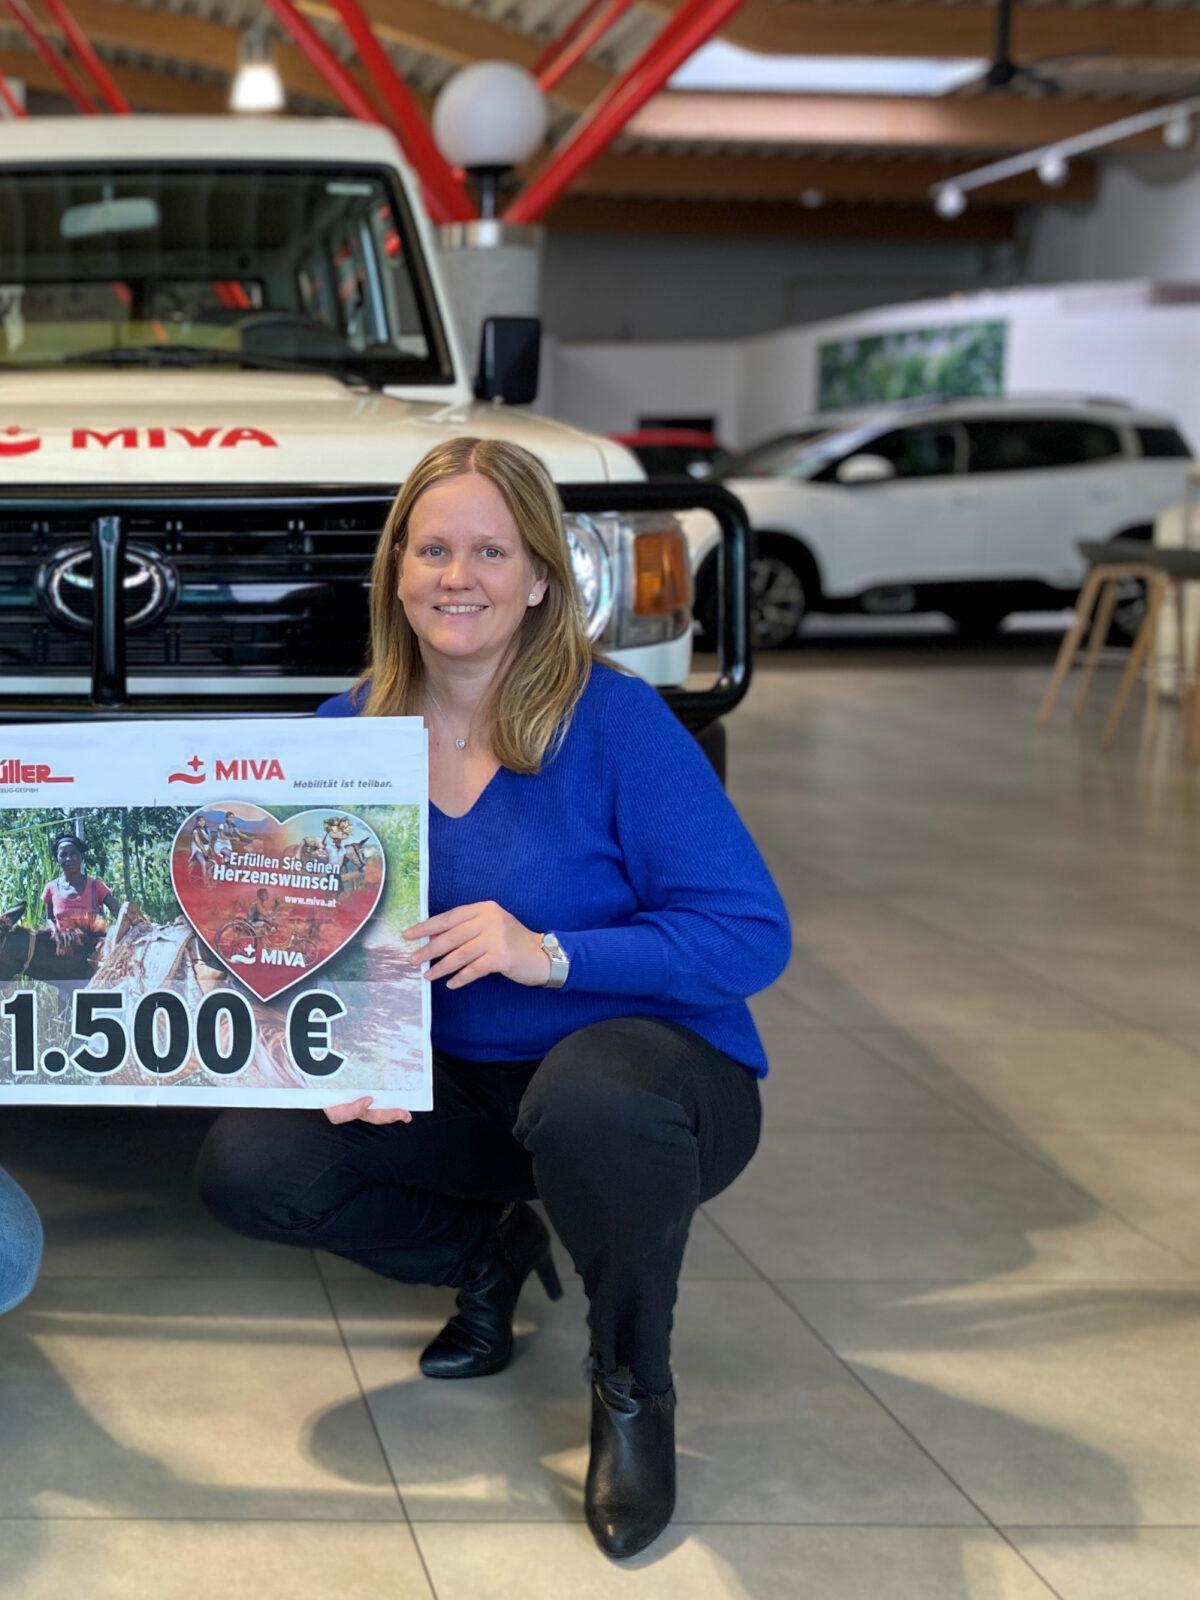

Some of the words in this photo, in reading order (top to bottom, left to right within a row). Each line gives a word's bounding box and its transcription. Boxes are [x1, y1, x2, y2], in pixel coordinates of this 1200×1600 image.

[71, 427, 279, 448] MIVA
[215, 759, 285, 781] MIVA
[293, 780, 338, 788] Mobilität
[340, 780, 354, 788] ist
[358, 779, 393, 788] teilbar.
[230, 852, 279, 869] Erfüllen
[283, 857, 302, 872] Sie
[306, 859, 341, 875] einen
[213, 864, 339, 892] Herzenswunsch
[284, 895, 337, 908] www.miva.at
[260, 948, 306, 968] MIVA
[2, 989, 254, 1076] 1.500
[285, 989, 348, 1077] €
